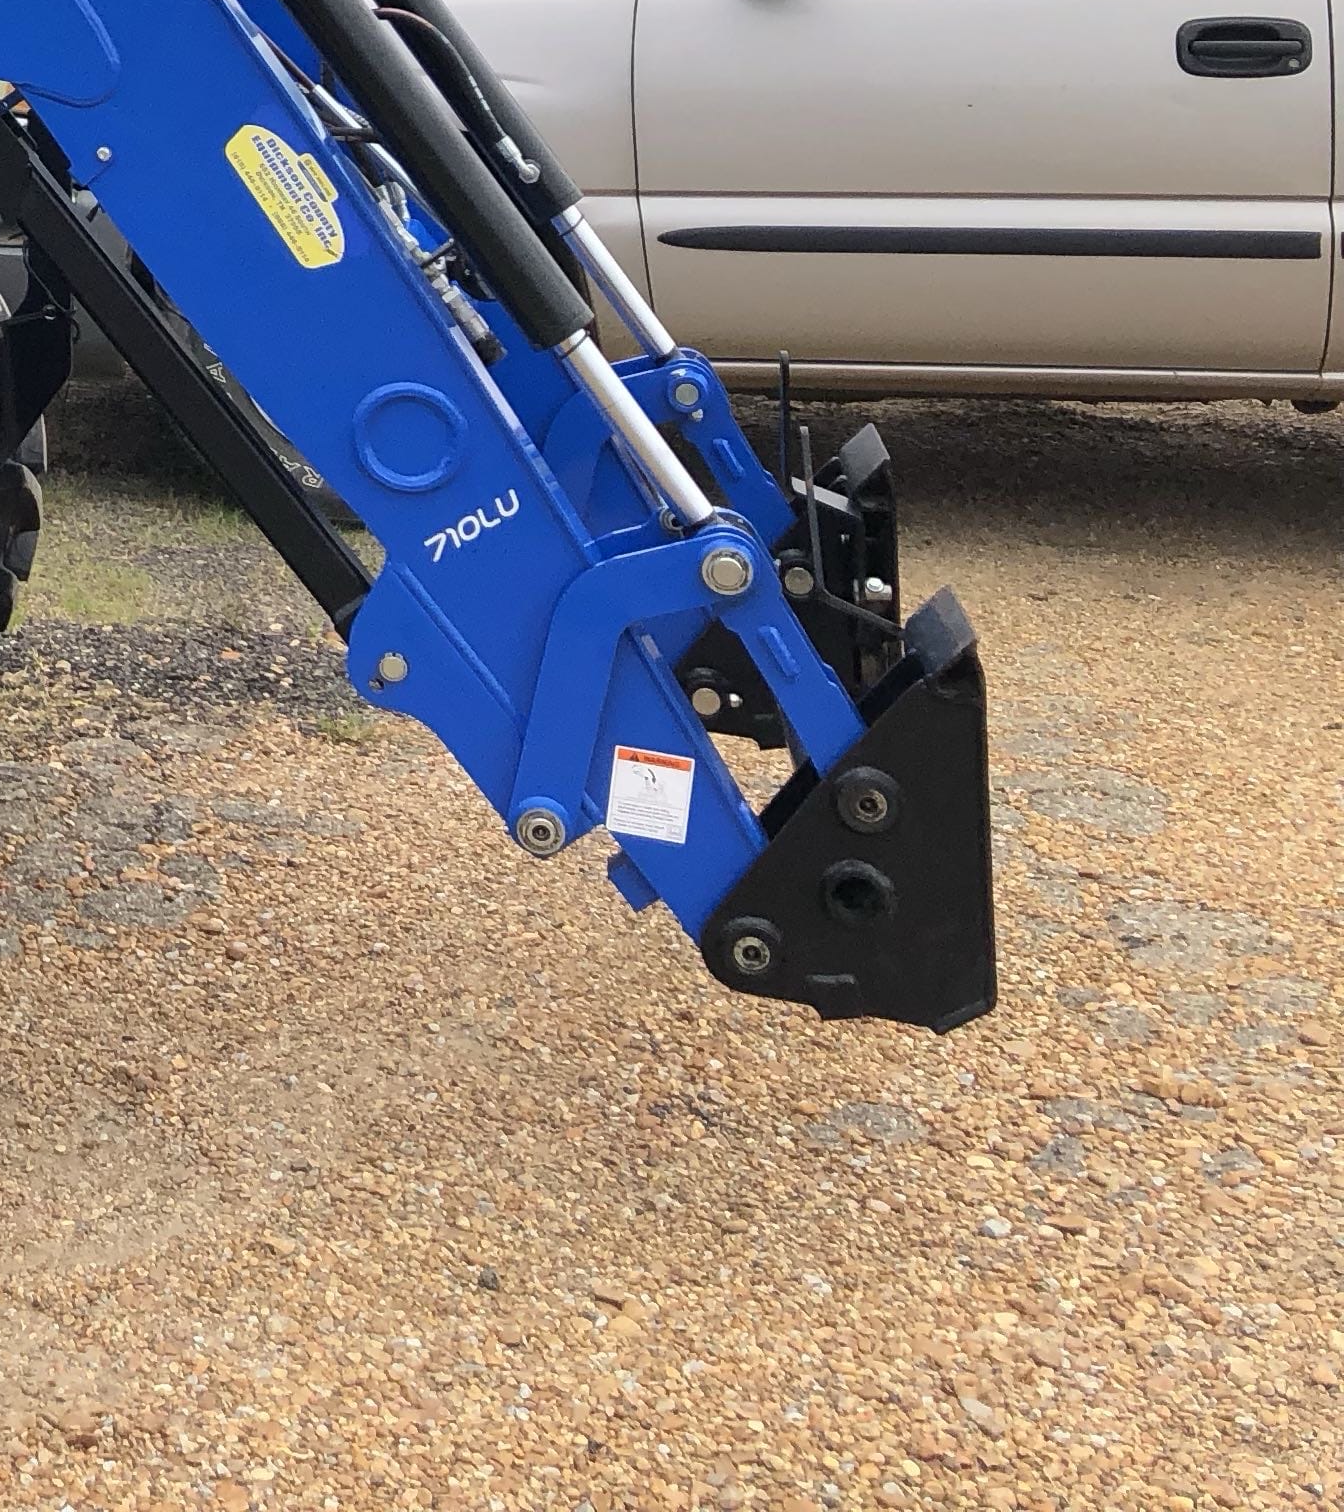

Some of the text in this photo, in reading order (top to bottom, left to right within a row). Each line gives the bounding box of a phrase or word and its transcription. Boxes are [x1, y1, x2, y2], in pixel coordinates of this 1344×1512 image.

[251, 135, 303, 204] Equipment
[266, 138, 306, 191] Dickson
[303, 192, 339, 239] County
[424, 488, 520, 563] 710LU
